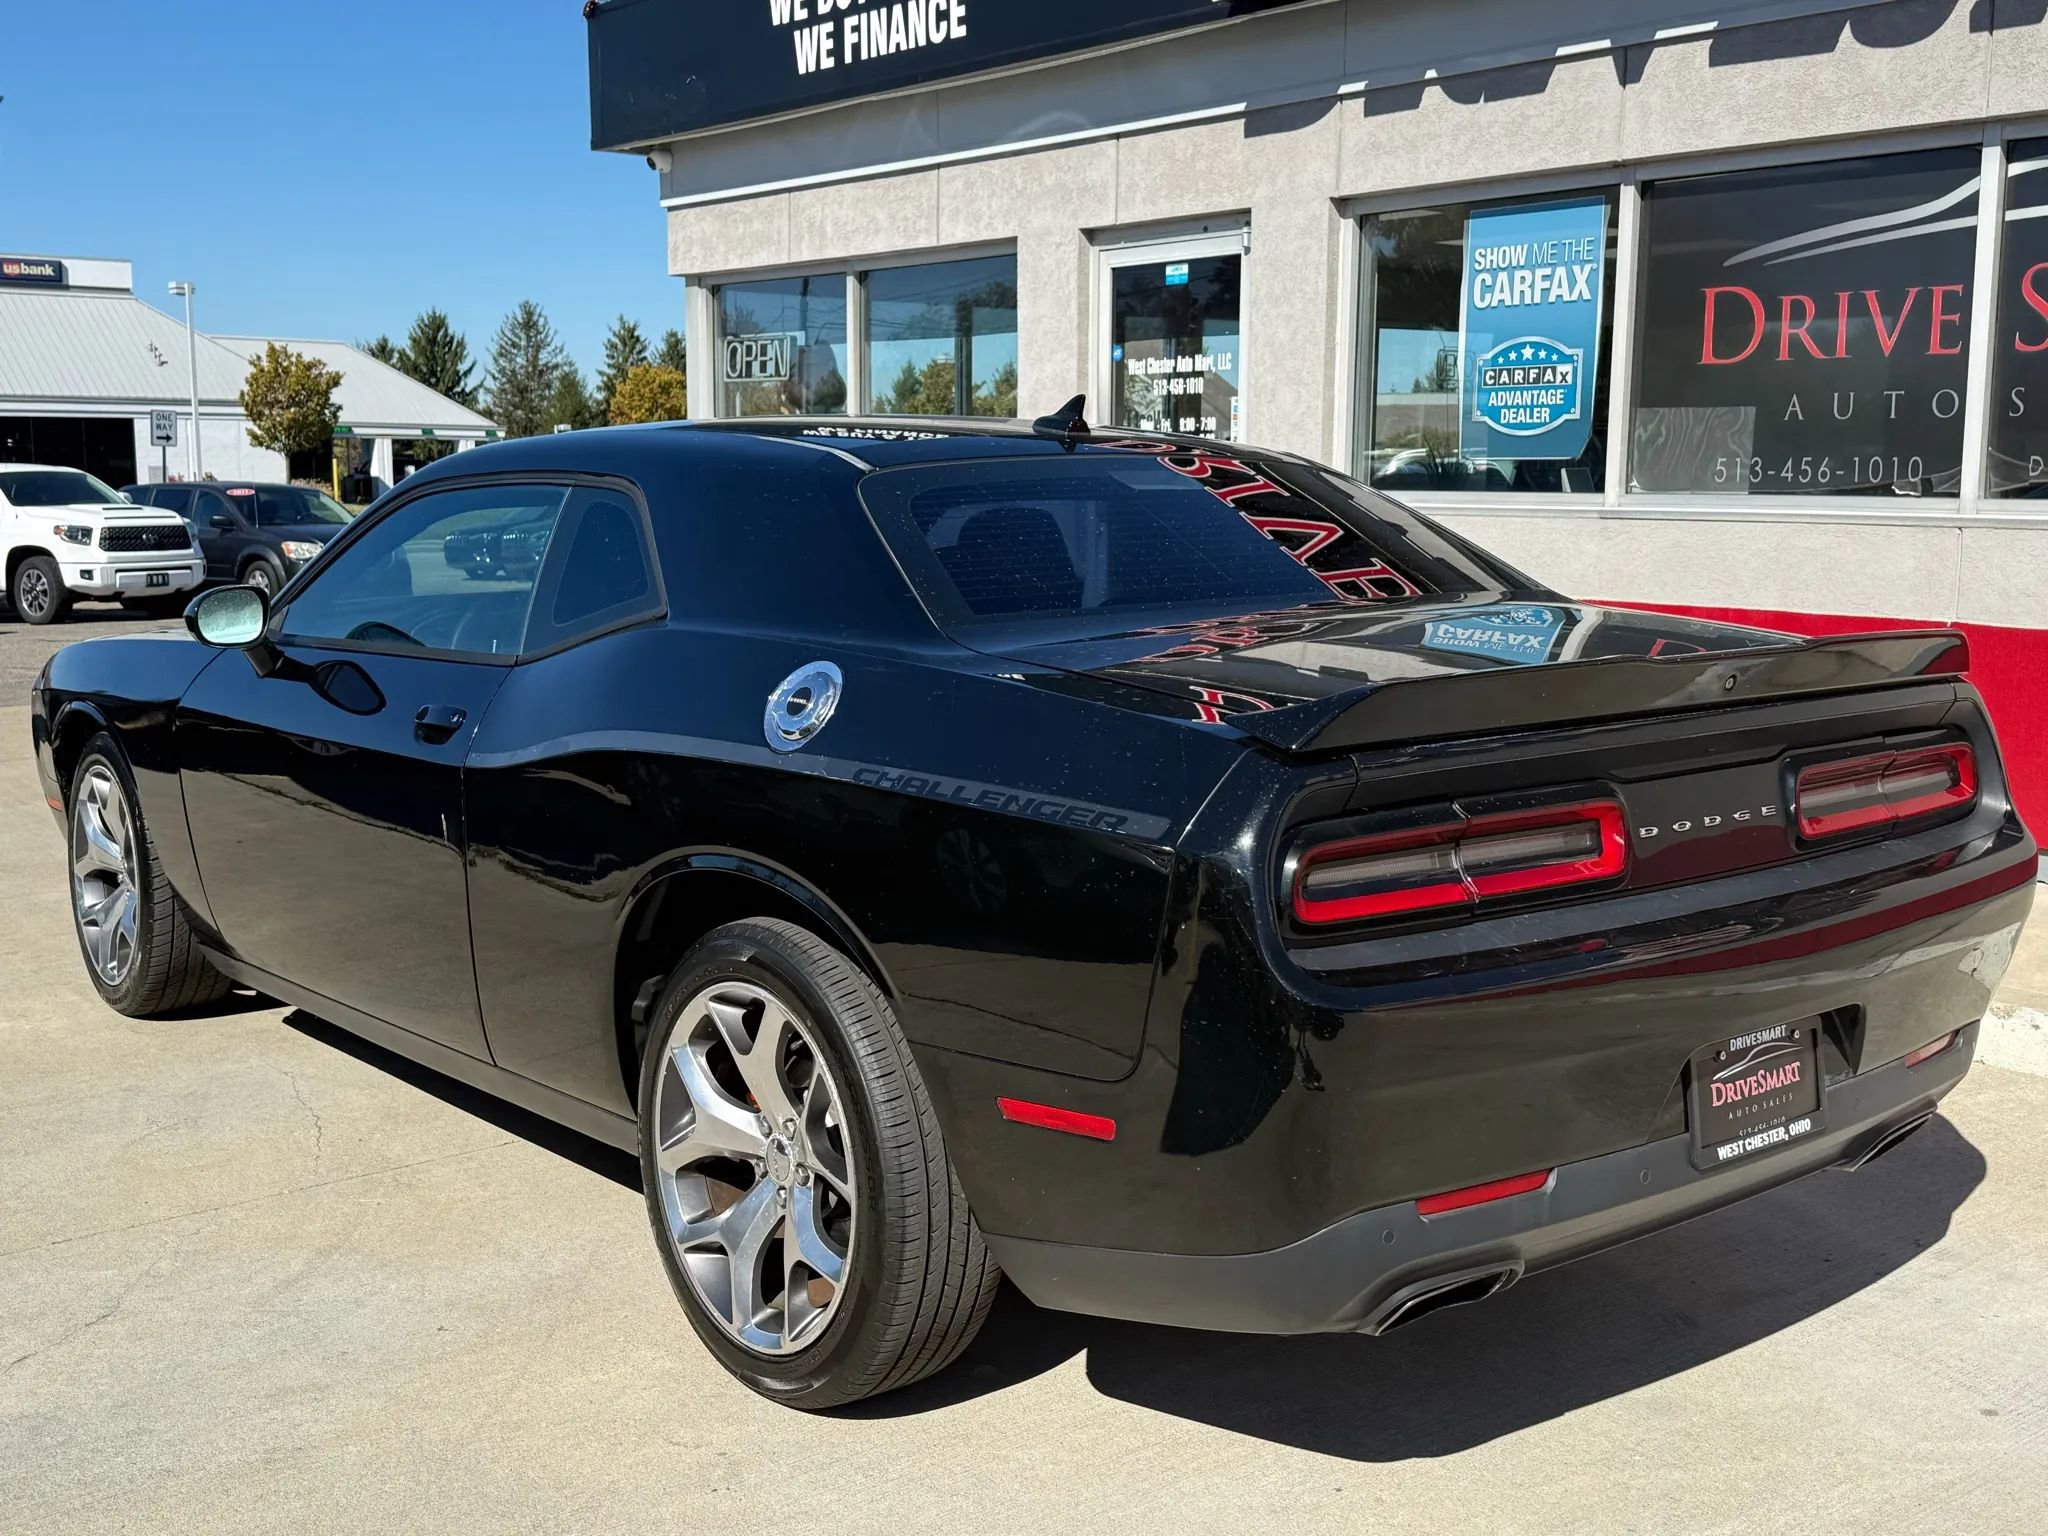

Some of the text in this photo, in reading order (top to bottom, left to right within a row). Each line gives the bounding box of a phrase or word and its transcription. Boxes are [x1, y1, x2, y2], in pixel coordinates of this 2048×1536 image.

[794, 0, 967, 75] WE FINANCE
[1474, 237, 1595, 271] SHOW ME THE
[1473, 263, 1594, 309] CARFAX
[1697, 283, 1964, 365] DRIVE
[727, 339, 788, 378] OPEN
[1128, 359, 1146, 375] West
[1147, 356, 1175, 374] Chester
[1176, 355, 1193, 372] Auto
[1217, 352, 1232, 370] LLC
[1484, 365, 1570, 386] CARFAX
[1488, 389, 1565, 407] ADVANTAGE
[1783, 388, 1960, 421] AUTO
[156, 412, 173, 421] ONE
[156, 422, 174, 432] WAY
[1501, 407, 1550, 424] DEALER
[1714, 456, 1924, 484] 513-456-1010
[852, 768, 1129, 833] CHALLENGER
[1639, 805, 1776, 838] DODGE
[1729, 1024, 1787, 1051] DRIVESMART
[1728, 1092, 1794, 1120] AUTO SALES
[1717, 1139, 1744, 1160] WEST
[1788, 1117, 1812, 1136] OHIO
